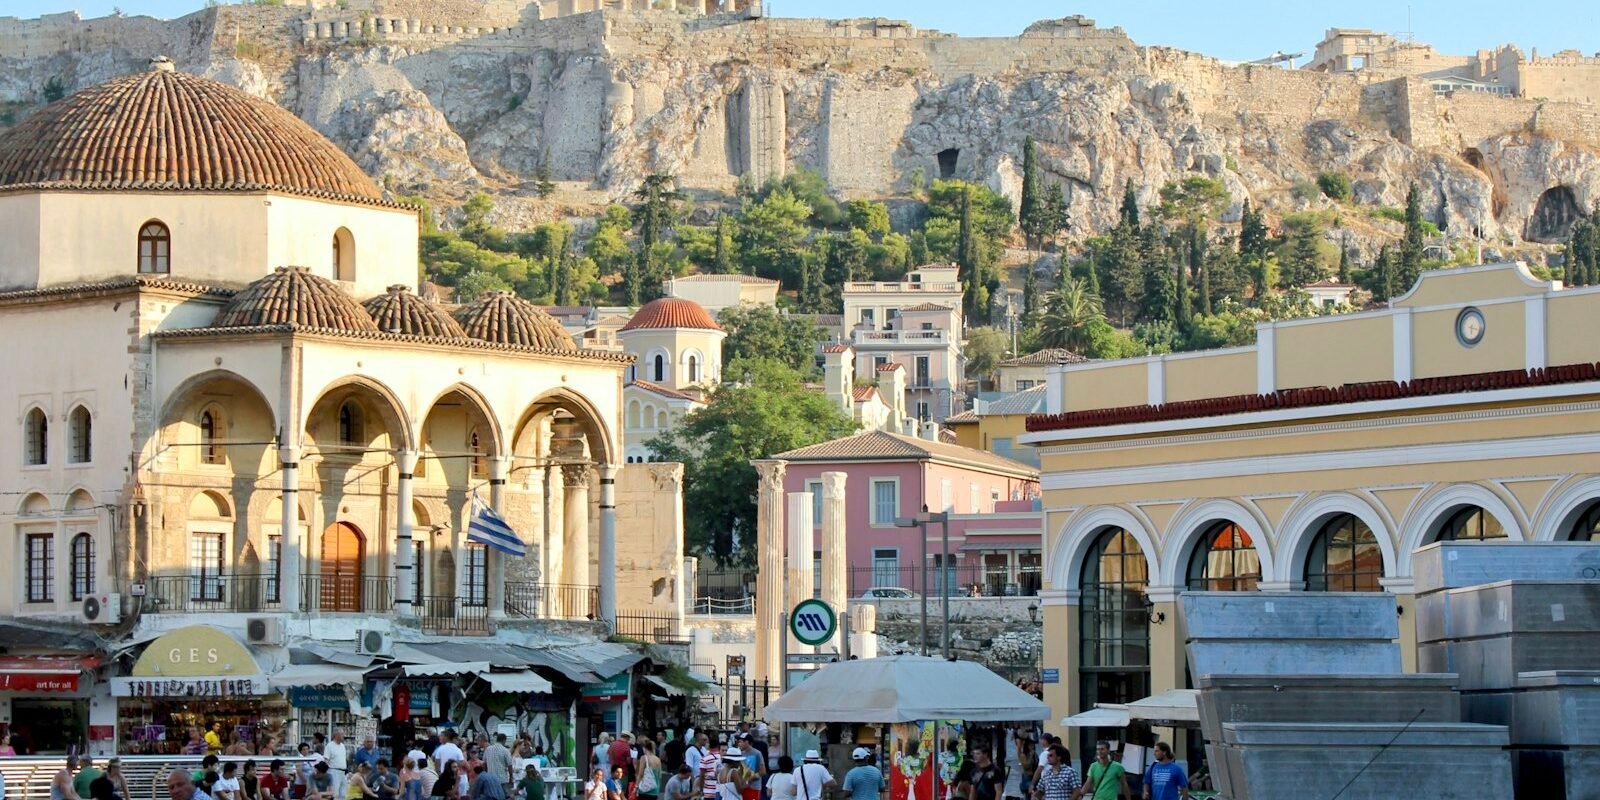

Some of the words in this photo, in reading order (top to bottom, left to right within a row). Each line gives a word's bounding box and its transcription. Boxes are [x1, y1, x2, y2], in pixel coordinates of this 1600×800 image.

[169, 647, 218, 664] GES
[49, 681, 59, 689] for
[62, 681, 72, 689] all
